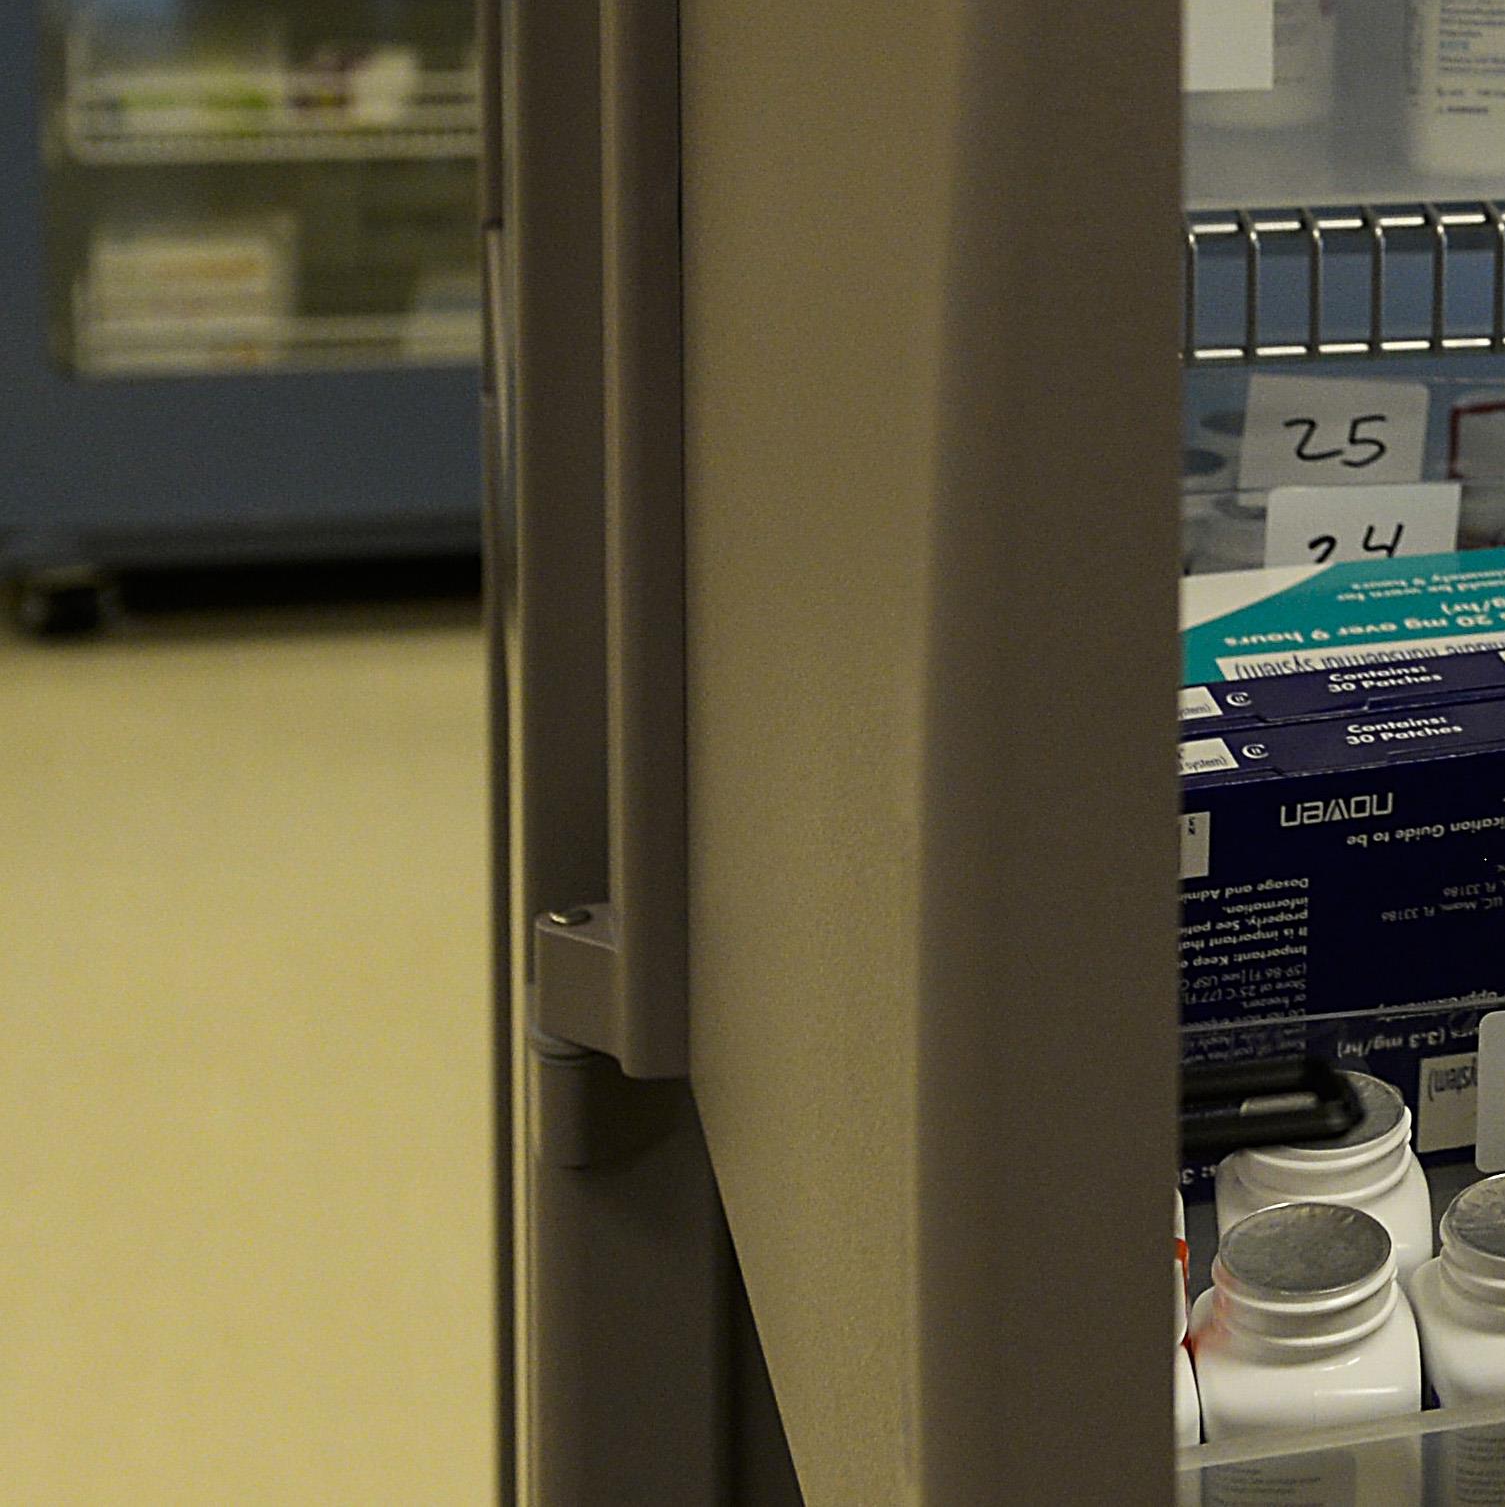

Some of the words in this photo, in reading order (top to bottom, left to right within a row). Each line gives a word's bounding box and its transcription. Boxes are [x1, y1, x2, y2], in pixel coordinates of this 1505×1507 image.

[1283, 414, 1389, 469] 25
[1336, 622, 1398, 637] over
[1403, 617, 1448, 630] mg
[1223, 631, 1304, 647] hours
[1311, 628, 1330, 641] 9
[1328, 665, 1427, 683] Contains:
[1328, 682, 1356, 693] 30
[1362, 673, 1442, 689] Patches
[1346, 715, 1447, 734] Contains:
[1345, 733, 1375, 746] 30
[1381, 724, 1463, 741] Patches
[1280, 791, 1394, 828] noven
[1346, 833, 1368, 848] be
[1373, 831, 1389, 844] to
[1395, 824, 1445, 841] Guide
[1225, 884, 1253, 899] and
[1257, 877, 1309, 892] Dosage
[1222, 896, 1309, 915] information.
[1215, 920, 1240, 930] See
[1245, 909, 1308, 929] properly.
[1209, 926, 1279, 947] important
[1283, 928, 1294, 939] is
[1299, 926, 1308, 937] It
[1193, 955, 1229, 967] Keep
[1233, 944, 1308, 963] Important:
